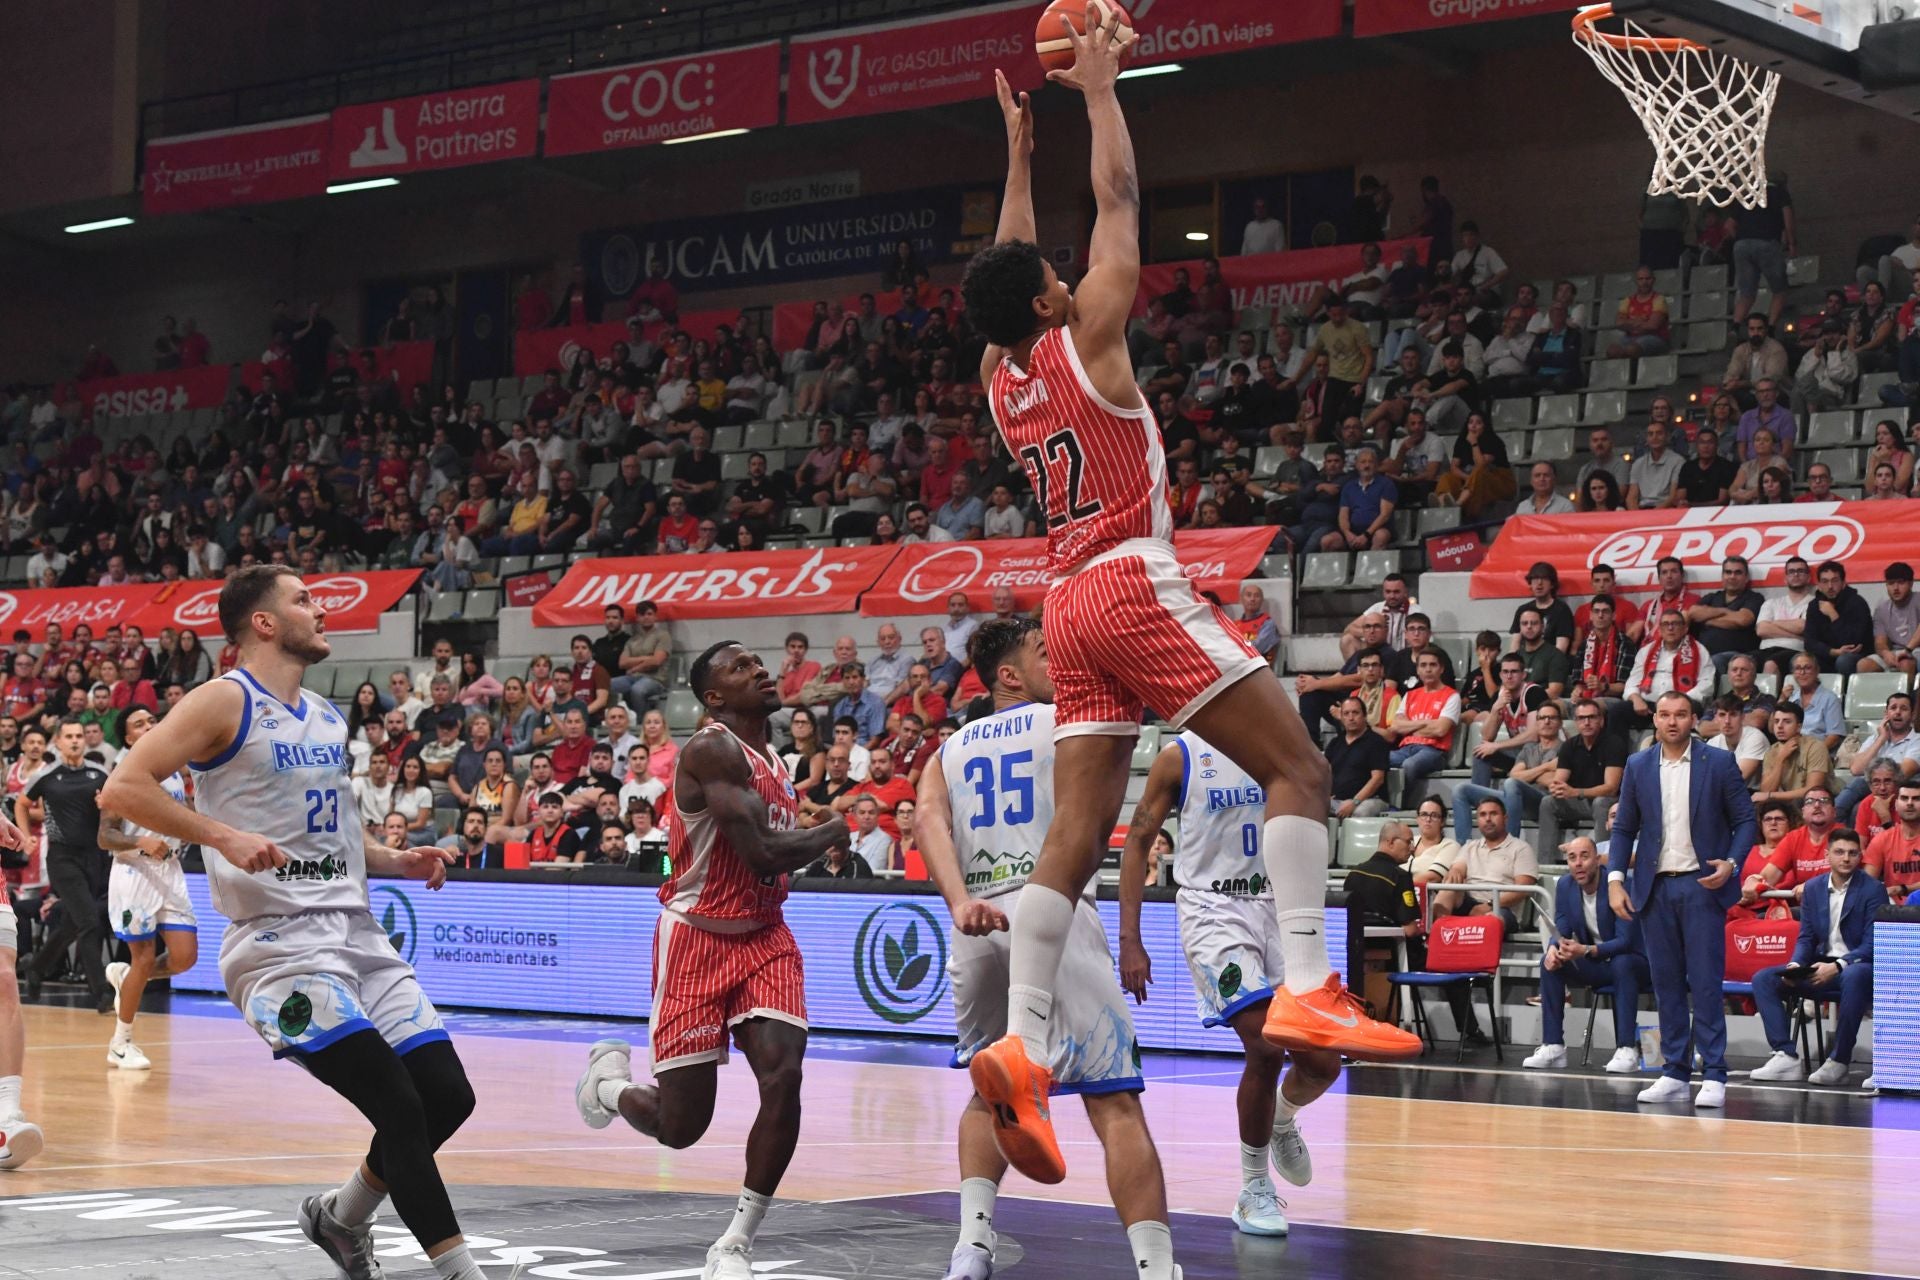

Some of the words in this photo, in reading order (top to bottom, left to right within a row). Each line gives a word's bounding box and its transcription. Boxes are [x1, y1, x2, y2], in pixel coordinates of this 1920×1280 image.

[890, 34, 1024, 74] GASOLINERAS
[1131, 20, 1220, 57] alcón
[1223, 22, 1275, 44] viajes
[417, 94, 506, 127] Asterra
[415, 126, 517, 161] Partners
[603, 116, 715, 145] OFTALMOLOGÍA
[173, 162, 242, 184] ESTRELLA
[254, 149, 321, 174] LEVANTE
[645, 228, 780, 280] UCAM
[785, 208, 937, 246] UNIVERSIDAD
[784, 245, 852, 269] CATÓLICA
[1020, 428, 1104, 531] 22
[1000, 557, 1034, 567] Costa
[1436, 542, 1475, 559] MÓDULO
[1184, 561, 1226, 578] CIA
[22, 599, 126, 625] LABASA
[962, 713, 1034, 746] BACHKOV
[963, 749, 1035, 831] 35
[306, 789, 338, 834] 23
[1242, 823, 1258, 857] 0
[433, 924, 458, 943] OC
[462, 926, 559, 947] Soluciones
[1458, 926, 1486, 936] UCAM
[1755, 935, 1788, 945] UCAM
[433, 948, 559, 967] Medioambientales
